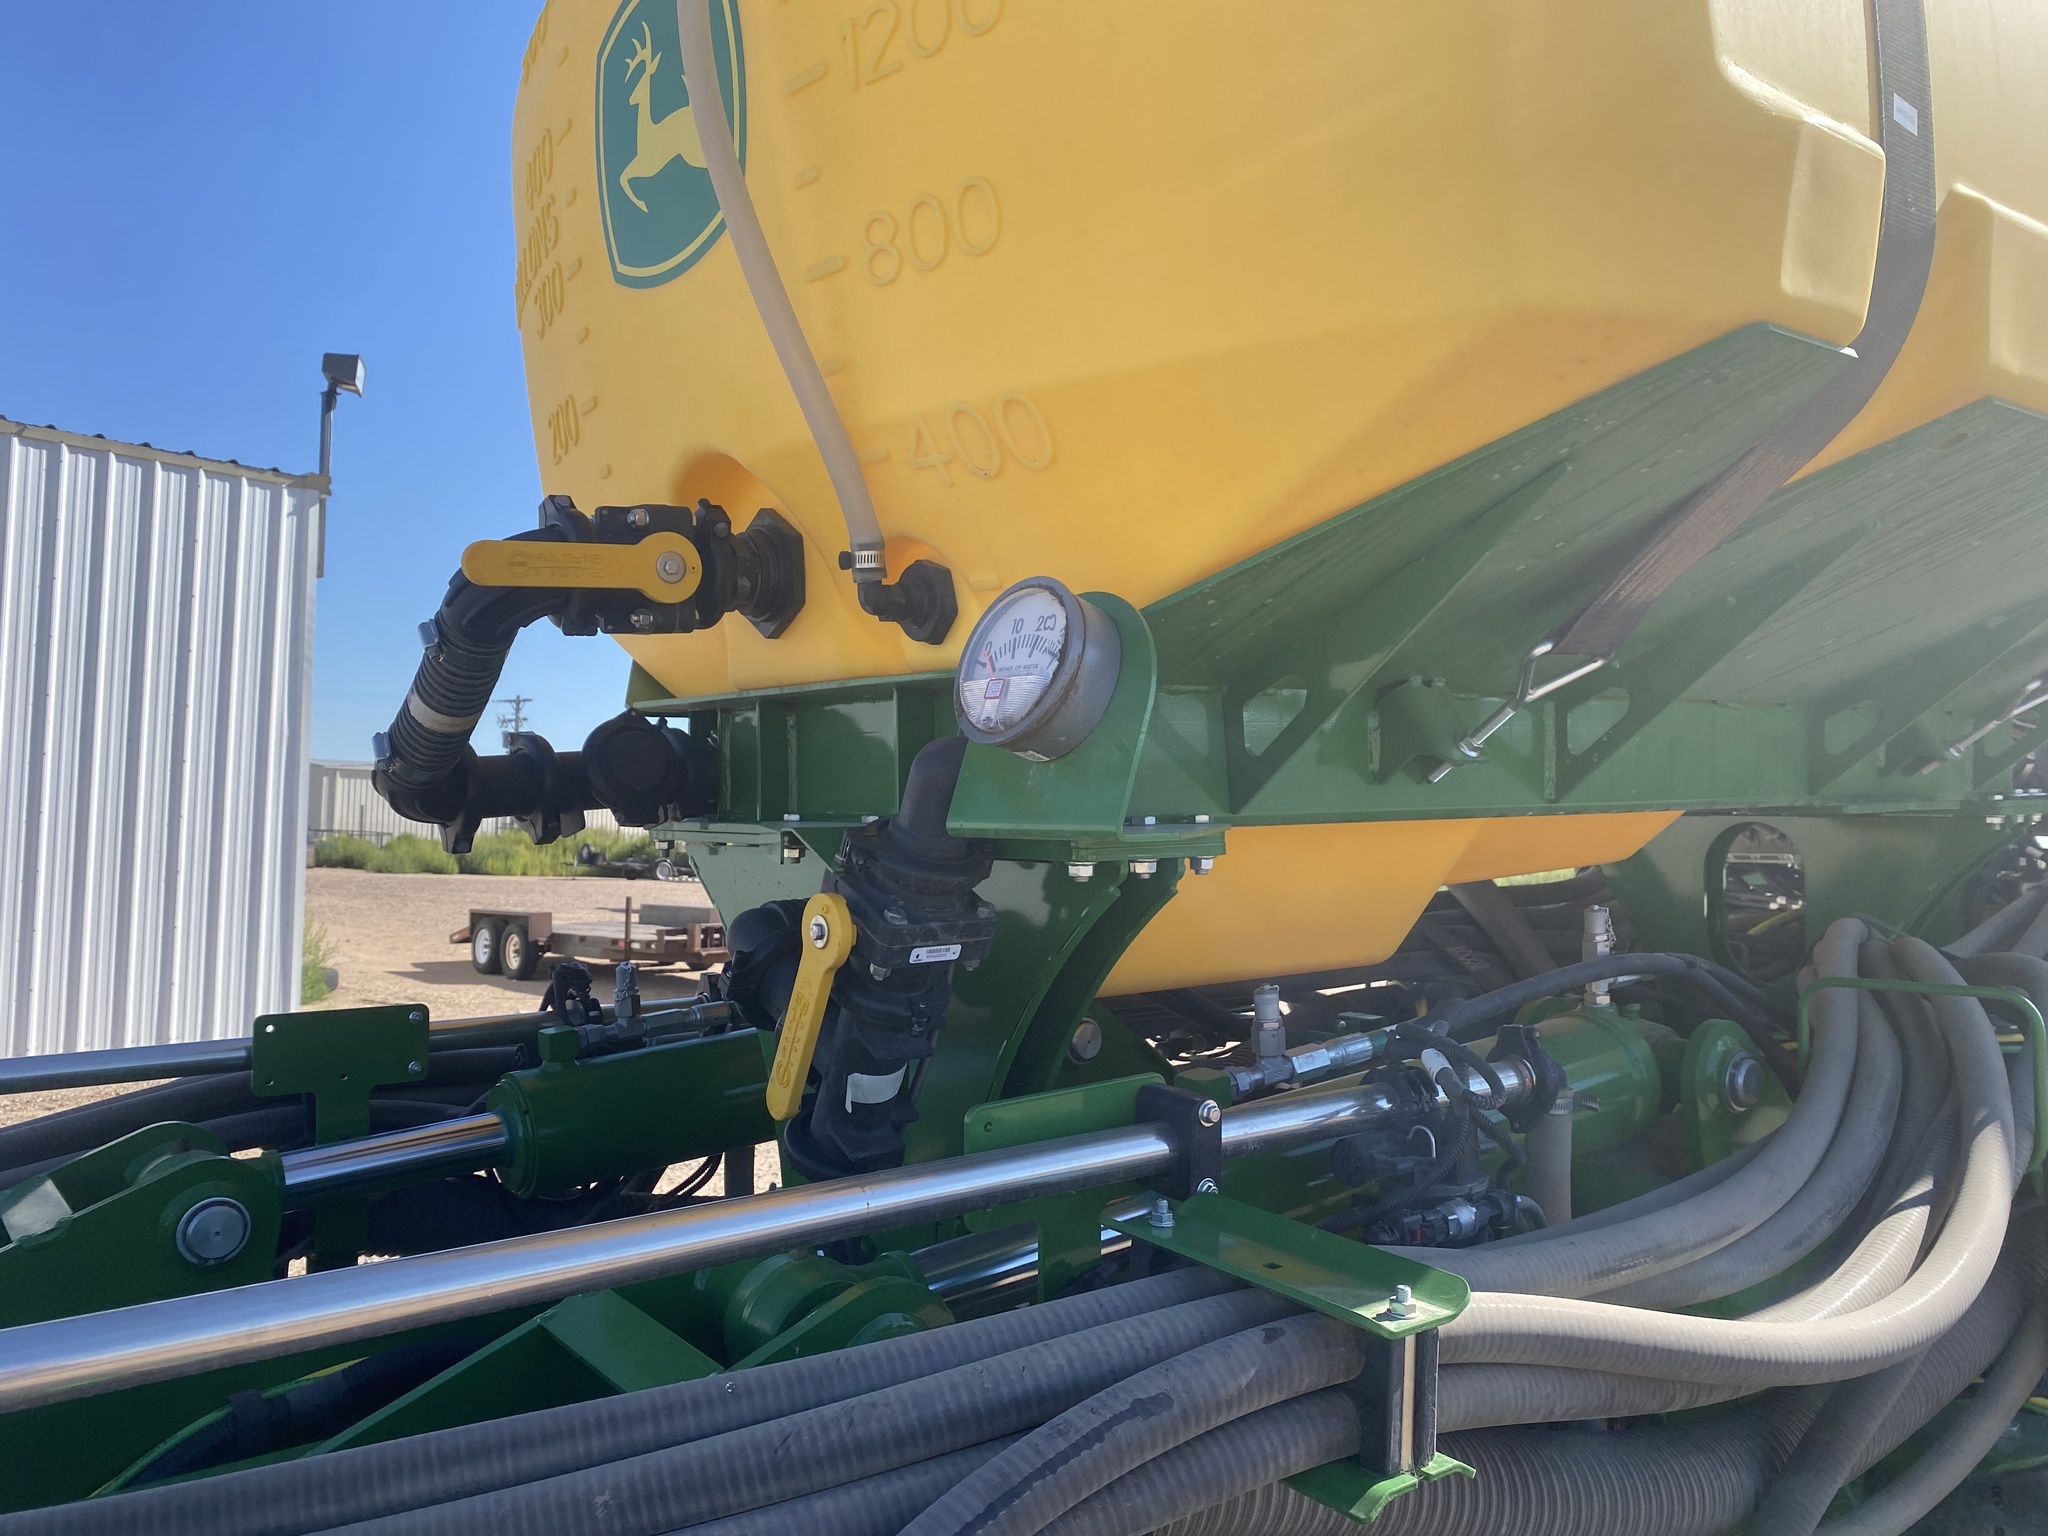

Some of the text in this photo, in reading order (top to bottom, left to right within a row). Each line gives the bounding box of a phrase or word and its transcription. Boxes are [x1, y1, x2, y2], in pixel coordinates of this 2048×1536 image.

[859, 176, 1001, 288] 800
[533, 261, 564, 340] 300
[547, 393, 580, 466] 200
[908, 389, 1054, 488] 400
[1011, 617, 1024, 635] 10
